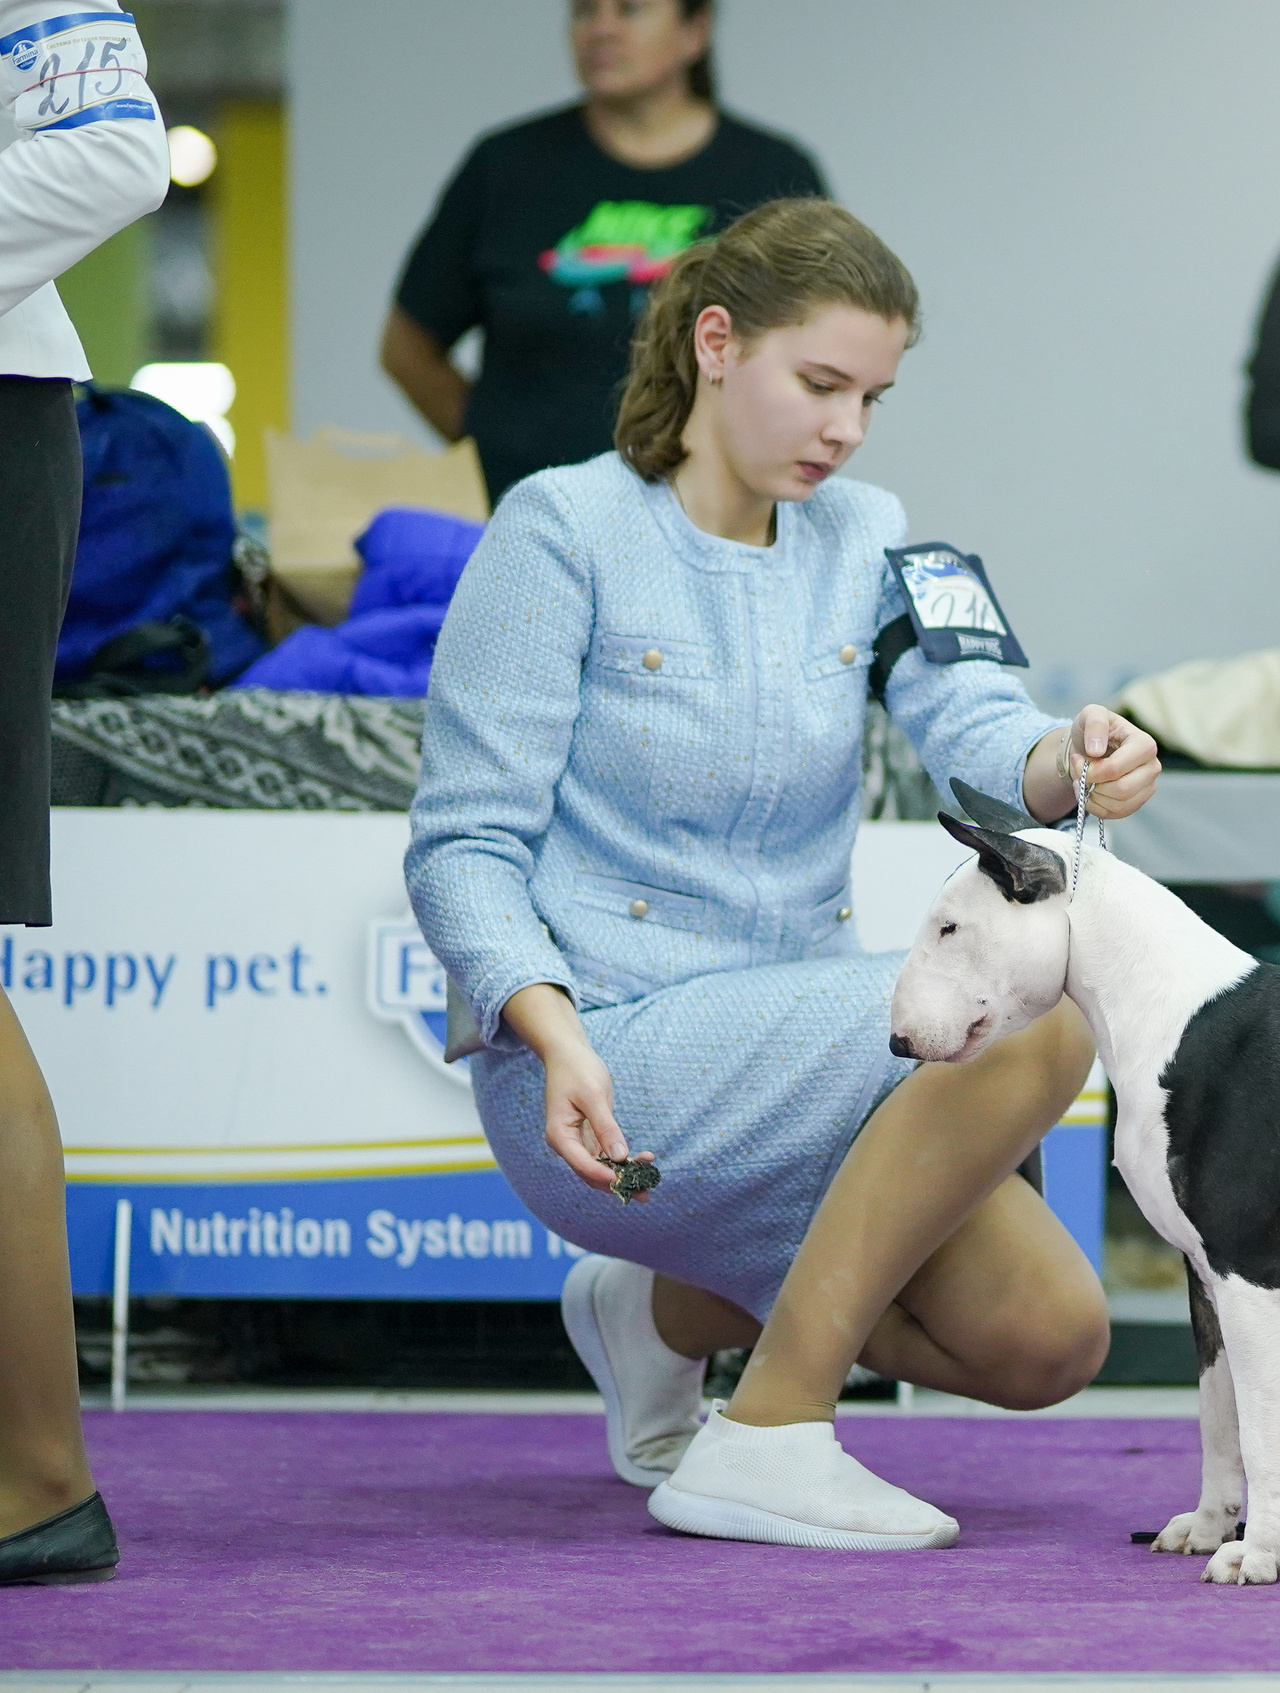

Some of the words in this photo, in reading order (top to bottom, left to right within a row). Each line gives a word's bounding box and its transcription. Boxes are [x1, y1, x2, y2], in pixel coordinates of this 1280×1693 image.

[11, 49, 39, 66] Farmina
[38, 38, 127, 116] 215
[205, 942, 329, 1008] pet.
[150, 1207, 351, 1258] Nutrition
[366, 1209, 532, 1268] System
